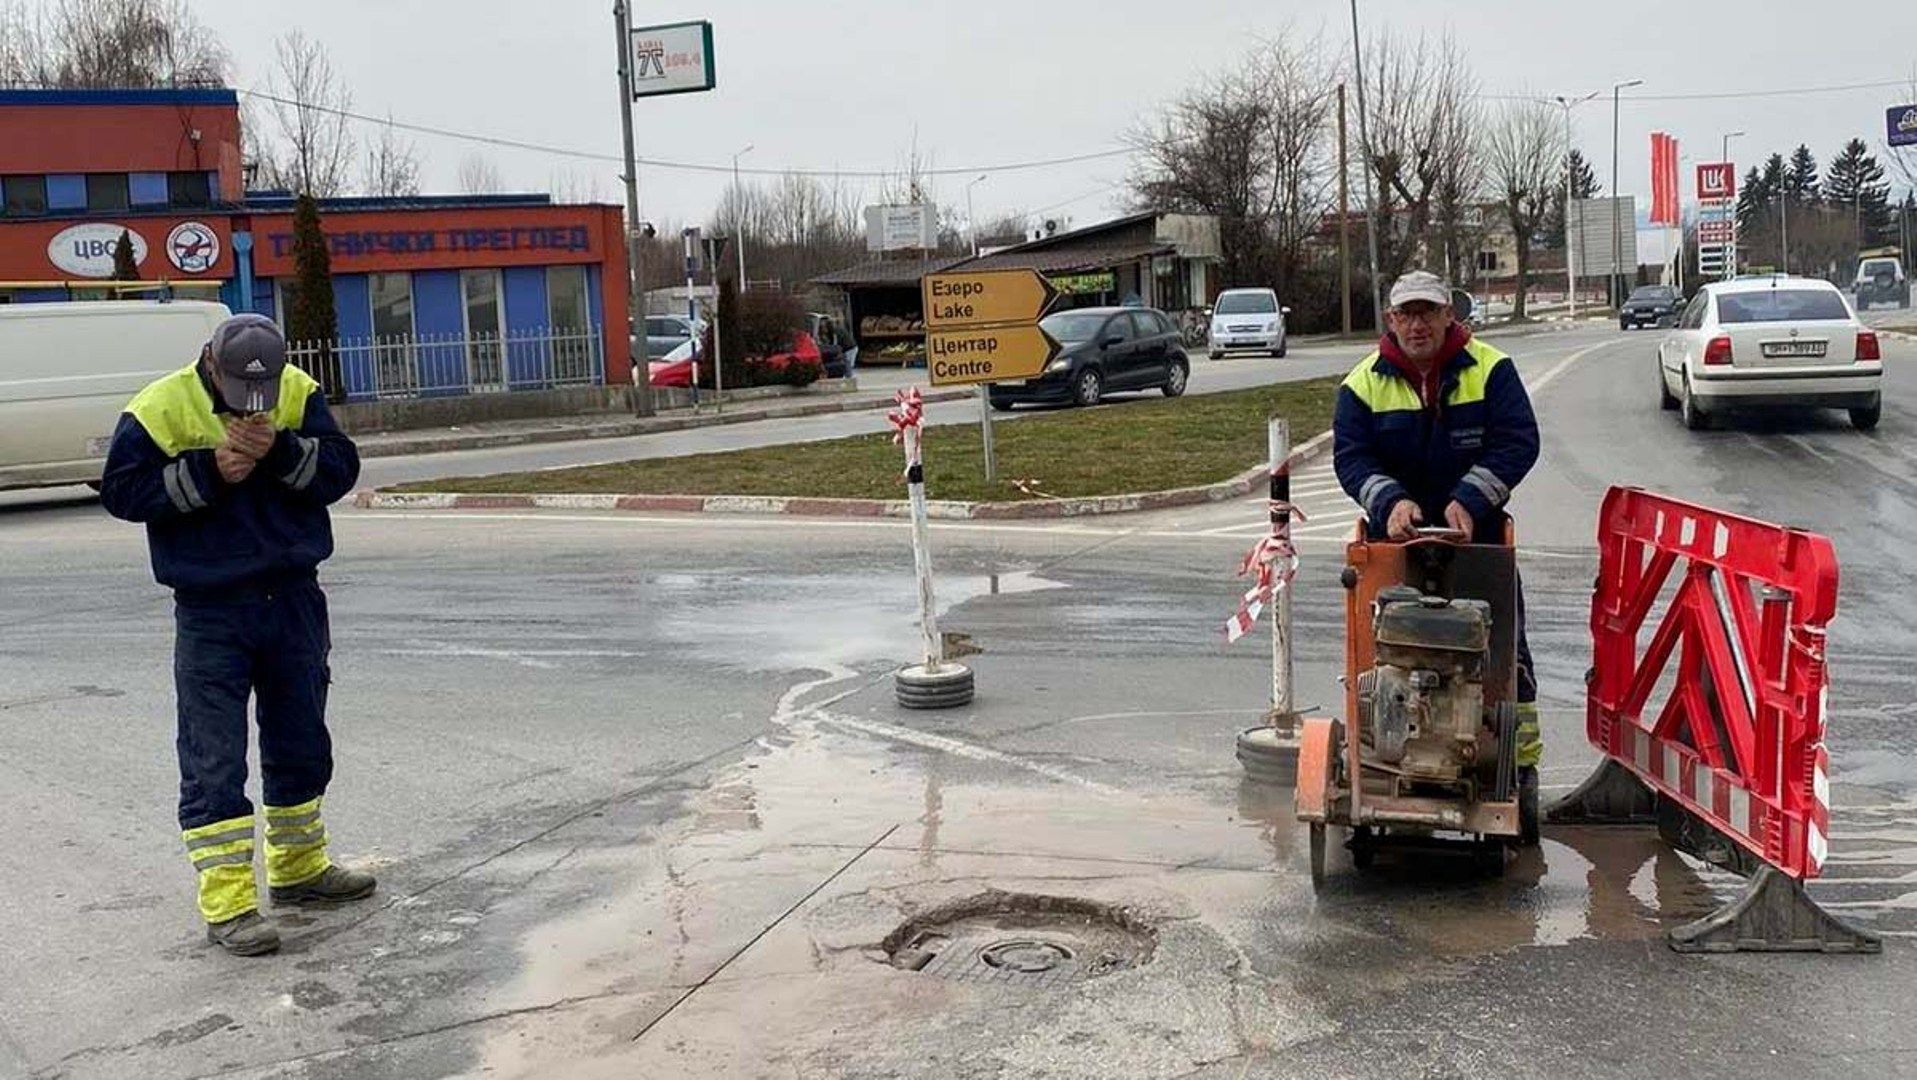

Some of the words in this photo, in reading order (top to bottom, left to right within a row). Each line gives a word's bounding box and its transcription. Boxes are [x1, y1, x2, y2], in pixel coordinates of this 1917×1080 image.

[268, 231, 435, 257] ТНИЧКИ
[932, 281, 983, 298] Езеро
[934, 303, 973, 319] Lake
[933, 338, 997, 357] Центар
[935, 361, 992, 377] Centre
